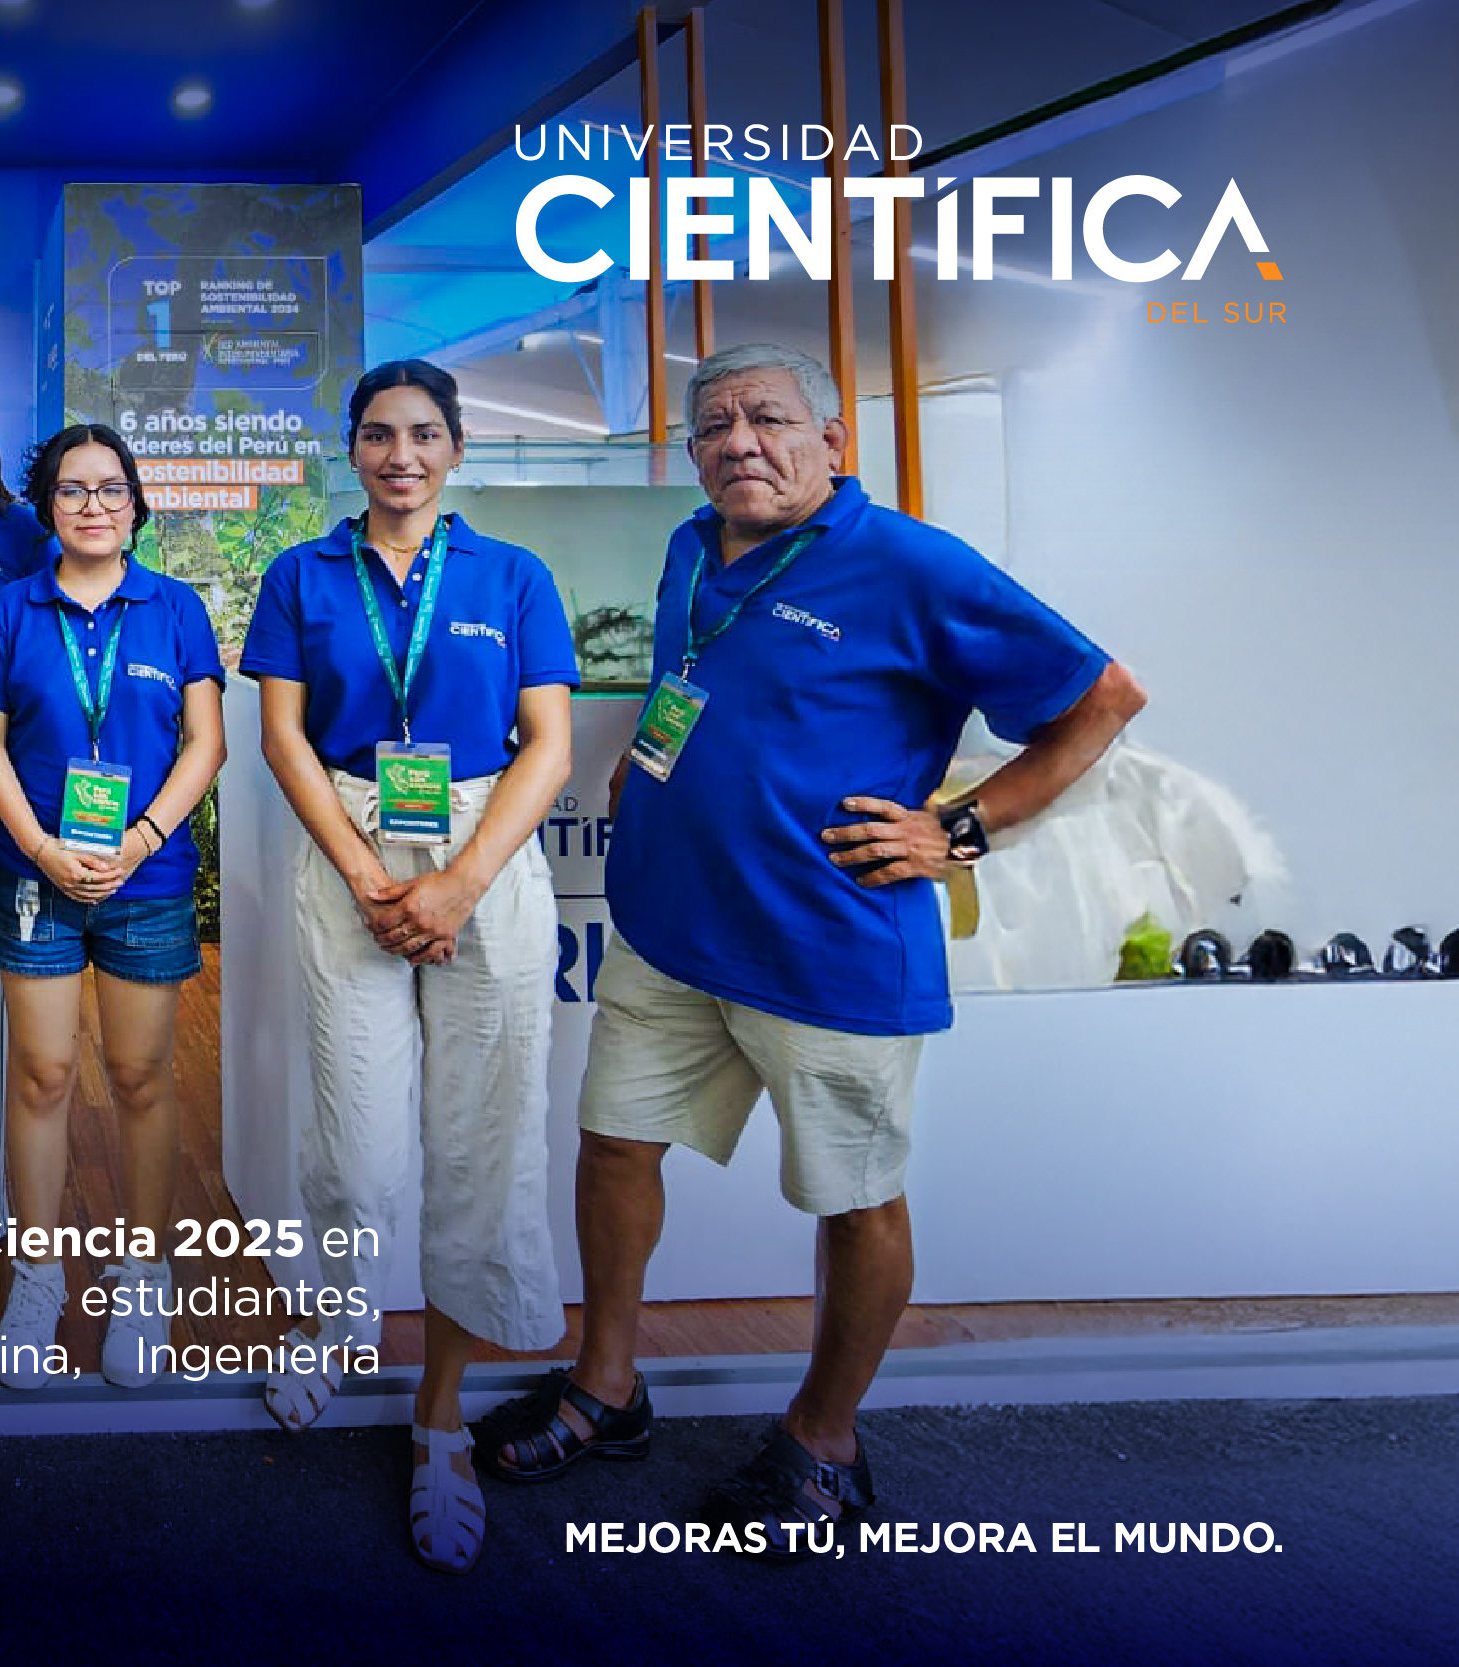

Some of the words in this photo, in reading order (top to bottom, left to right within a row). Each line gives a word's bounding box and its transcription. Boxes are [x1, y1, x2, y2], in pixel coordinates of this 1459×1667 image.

[144, 280, 182, 296] TOP
[201, 280, 254, 290] RANKING
[257, 280, 273, 290] DE
[201, 292, 297, 302] SOSTENIBILIDAD
[201, 304, 268, 314] AMBIENTAL
[147, 302, 171, 348] 1
[137, 353, 157, 362] DEL
[159, 350, 187, 362] PERÚ
[119, 410, 138, 431] 6
[144, 409, 207, 432] años
[214, 409, 302, 432] siendo
[199, 435, 232, 454] del
[239, 434, 288, 454] Perú
[294, 440, 321, 454] en
[137, 460, 299, 482] ostenibilidad
